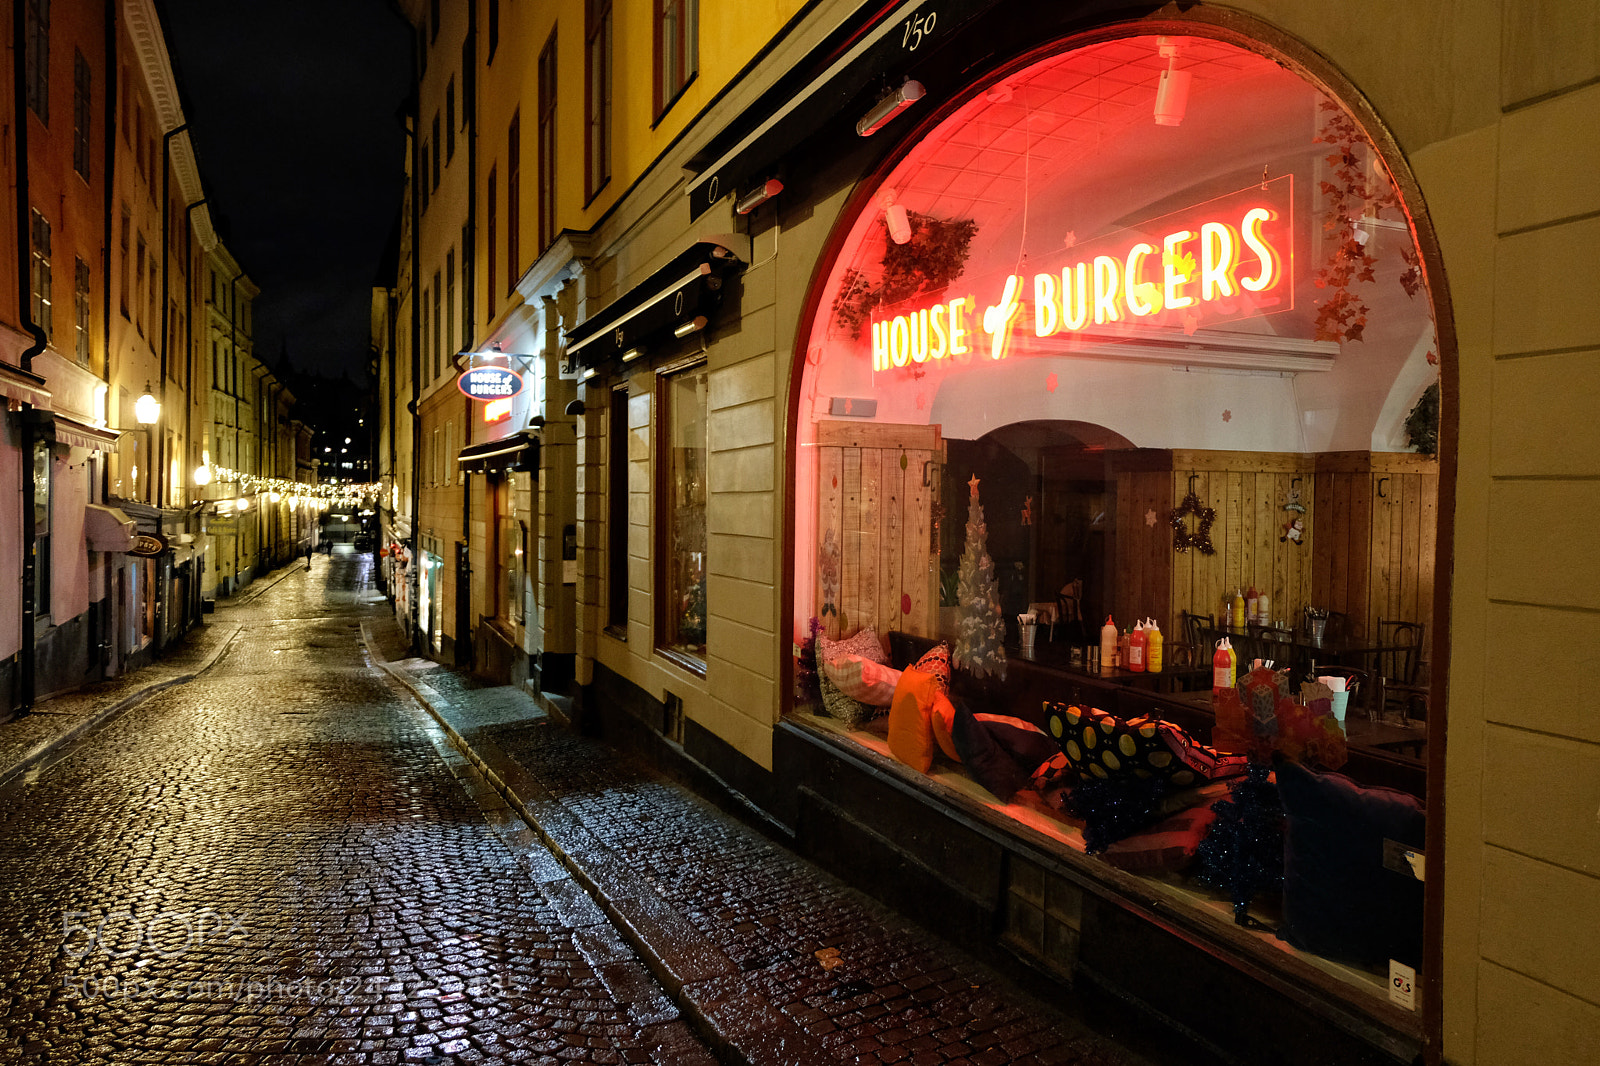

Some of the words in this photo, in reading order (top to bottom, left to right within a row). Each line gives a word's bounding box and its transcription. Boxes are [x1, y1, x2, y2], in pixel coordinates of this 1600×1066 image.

[872, 297, 969, 372] HOUSE
[983, 274, 1020, 360] of
[1034, 207, 1275, 338] BURGERS
[470, 372, 502, 384] HOUSE
[470, 384, 513, 395] BURGERS
